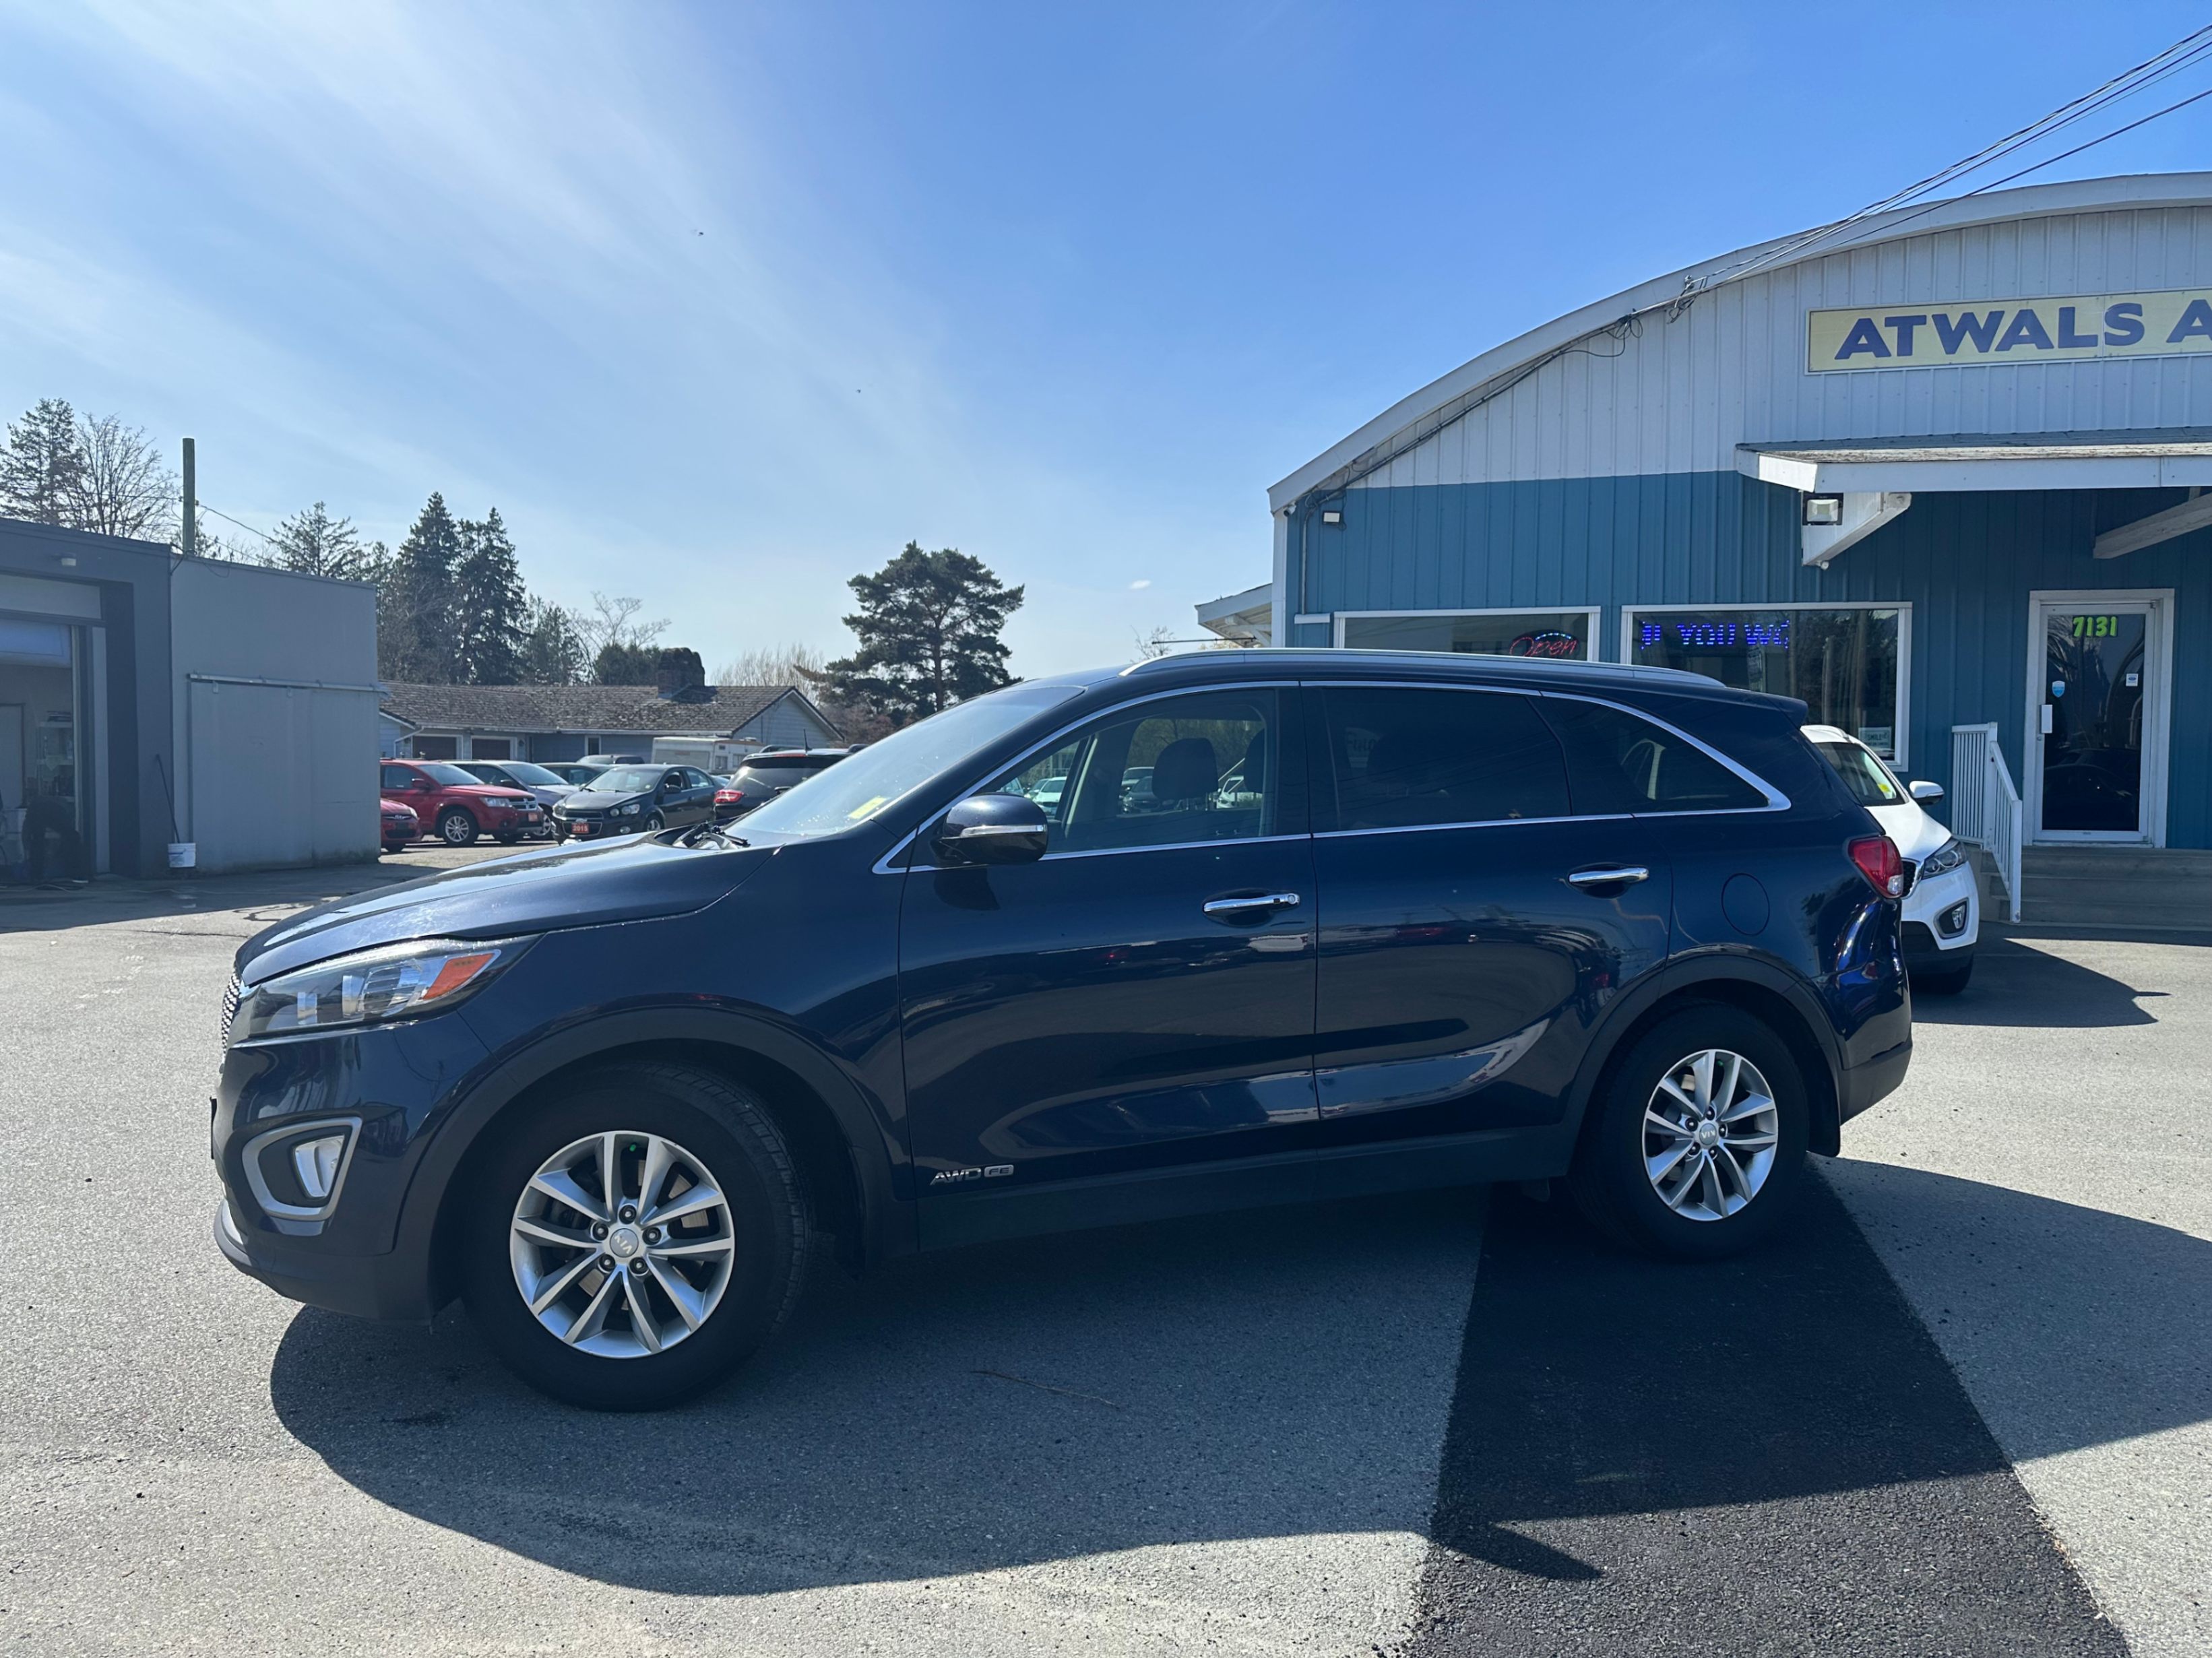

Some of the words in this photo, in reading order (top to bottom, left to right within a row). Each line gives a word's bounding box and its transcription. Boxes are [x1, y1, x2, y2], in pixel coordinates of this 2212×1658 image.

[1833, 302, 2145, 360] ATWALS
[1676, 623, 1736, 645] YOU
[2073, 616, 2118, 637] 7131
[1509, 636, 1577, 658] Open
[930, 1168, 982, 1185] AWD
